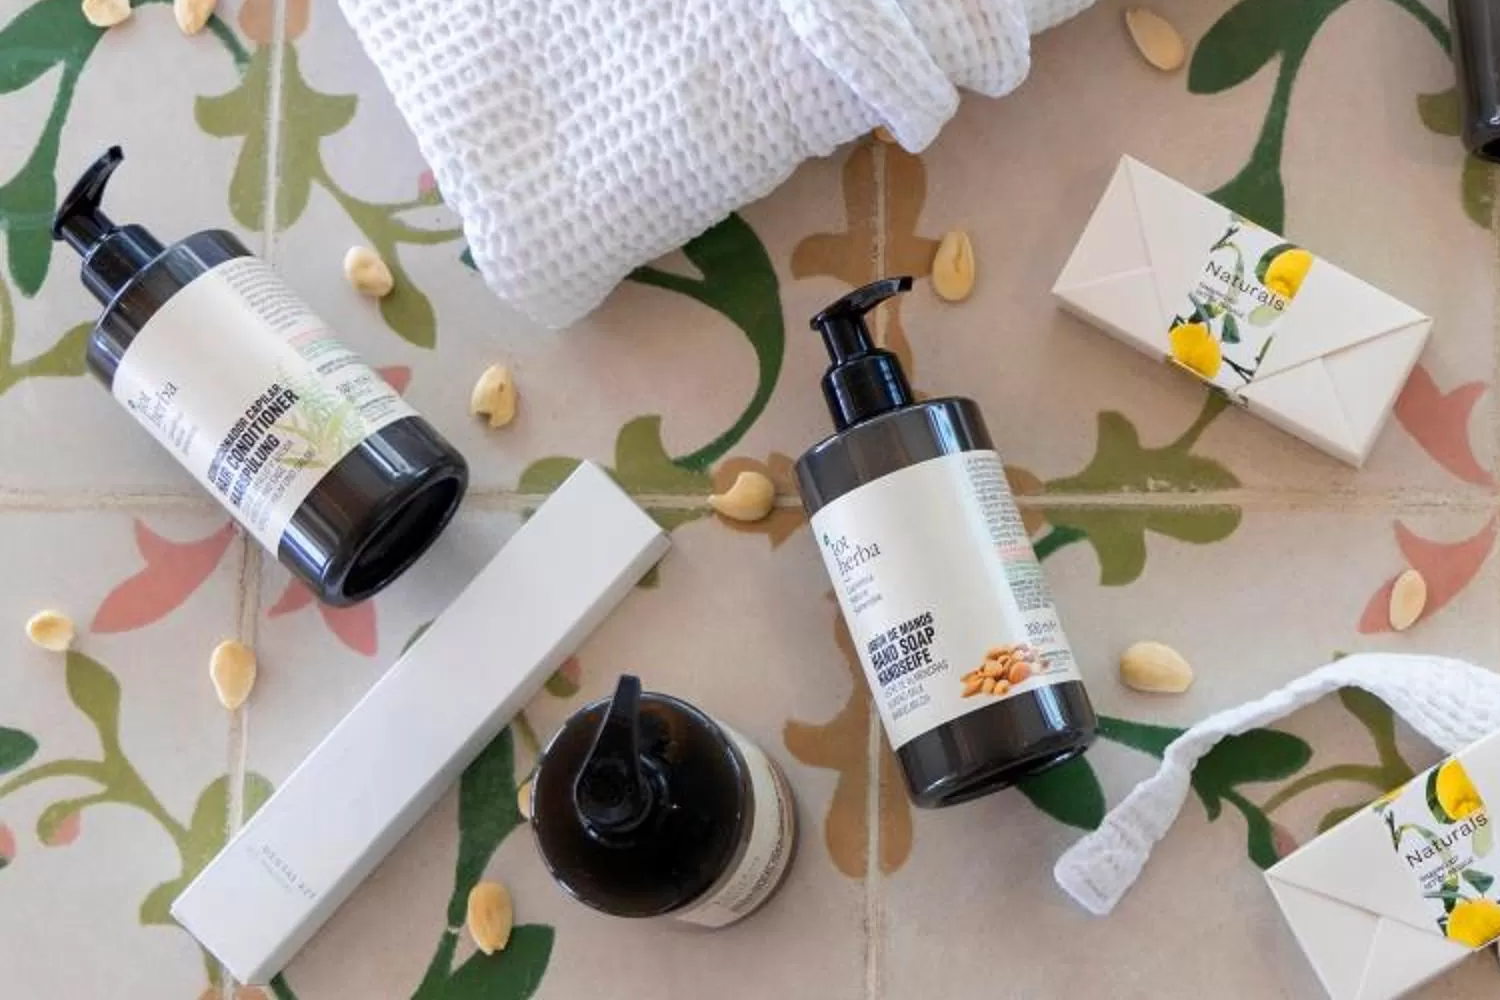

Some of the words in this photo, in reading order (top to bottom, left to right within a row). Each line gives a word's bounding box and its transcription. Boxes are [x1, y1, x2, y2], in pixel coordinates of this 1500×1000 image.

[1206, 262, 1282, 309] Naturals
[244, 383, 281, 419] CAPILAR
[226, 390, 298, 468] CONDITIONER
[899, 626, 936, 653] SOAP
[1406, 813, 1487, 866] Naturals
